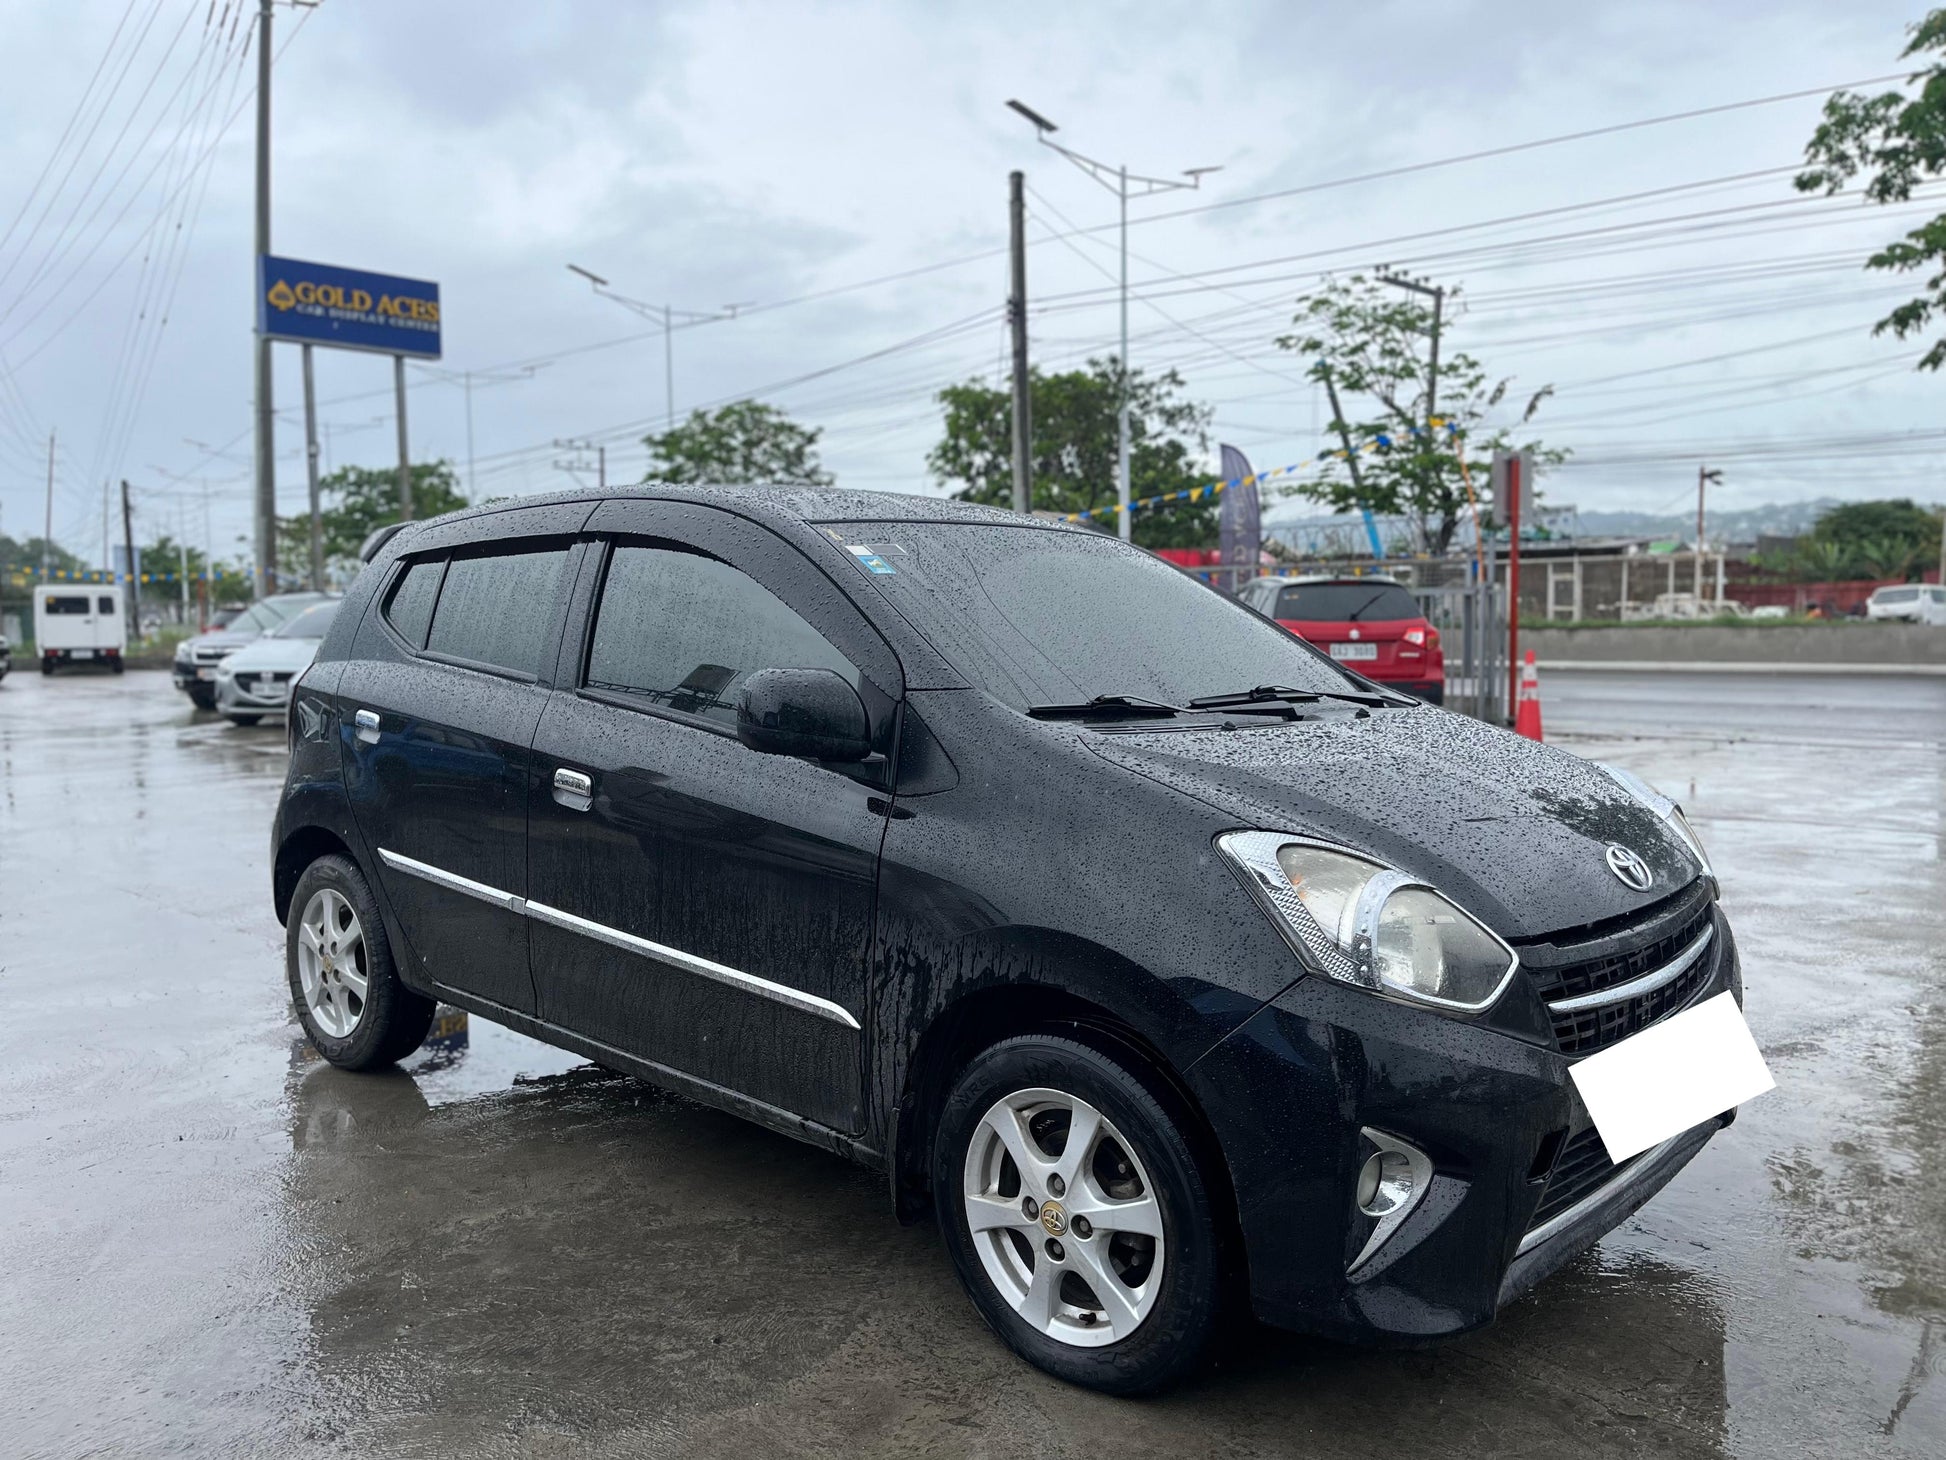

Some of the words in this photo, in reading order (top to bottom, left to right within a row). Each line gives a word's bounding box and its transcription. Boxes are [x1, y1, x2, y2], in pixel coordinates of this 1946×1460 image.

[294, 281, 372, 312] GOLD
[377, 294, 439, 322] ACES
[296, 303, 324, 318] CAR
[329, 307, 387, 326] DISPLAY
[388, 315, 439, 332] CENTER
